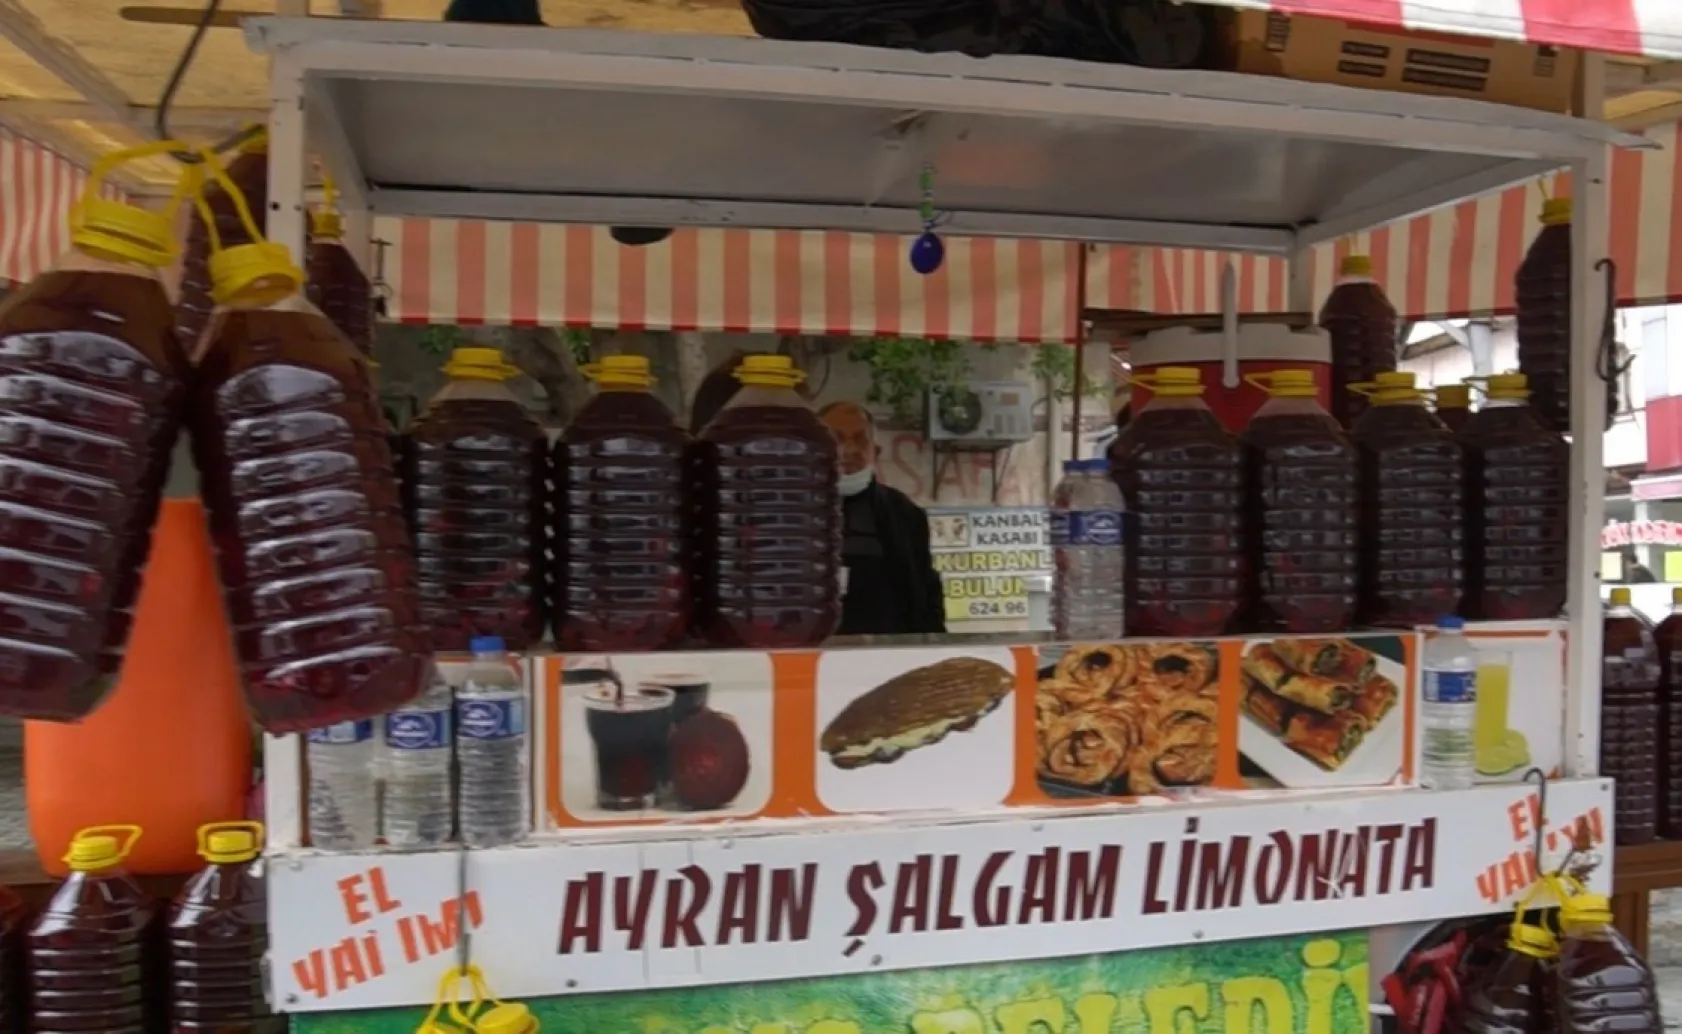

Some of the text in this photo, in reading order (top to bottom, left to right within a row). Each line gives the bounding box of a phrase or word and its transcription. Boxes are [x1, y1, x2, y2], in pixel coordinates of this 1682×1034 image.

[977, 531, 1038, 545] KASABI
[969, 603, 999, 615] 624
[1507, 794, 1549, 842] EL
[337, 866, 402, 925] EL
[559, 817, 1436, 957] AYRAN ŞALGAM LİMONATA
